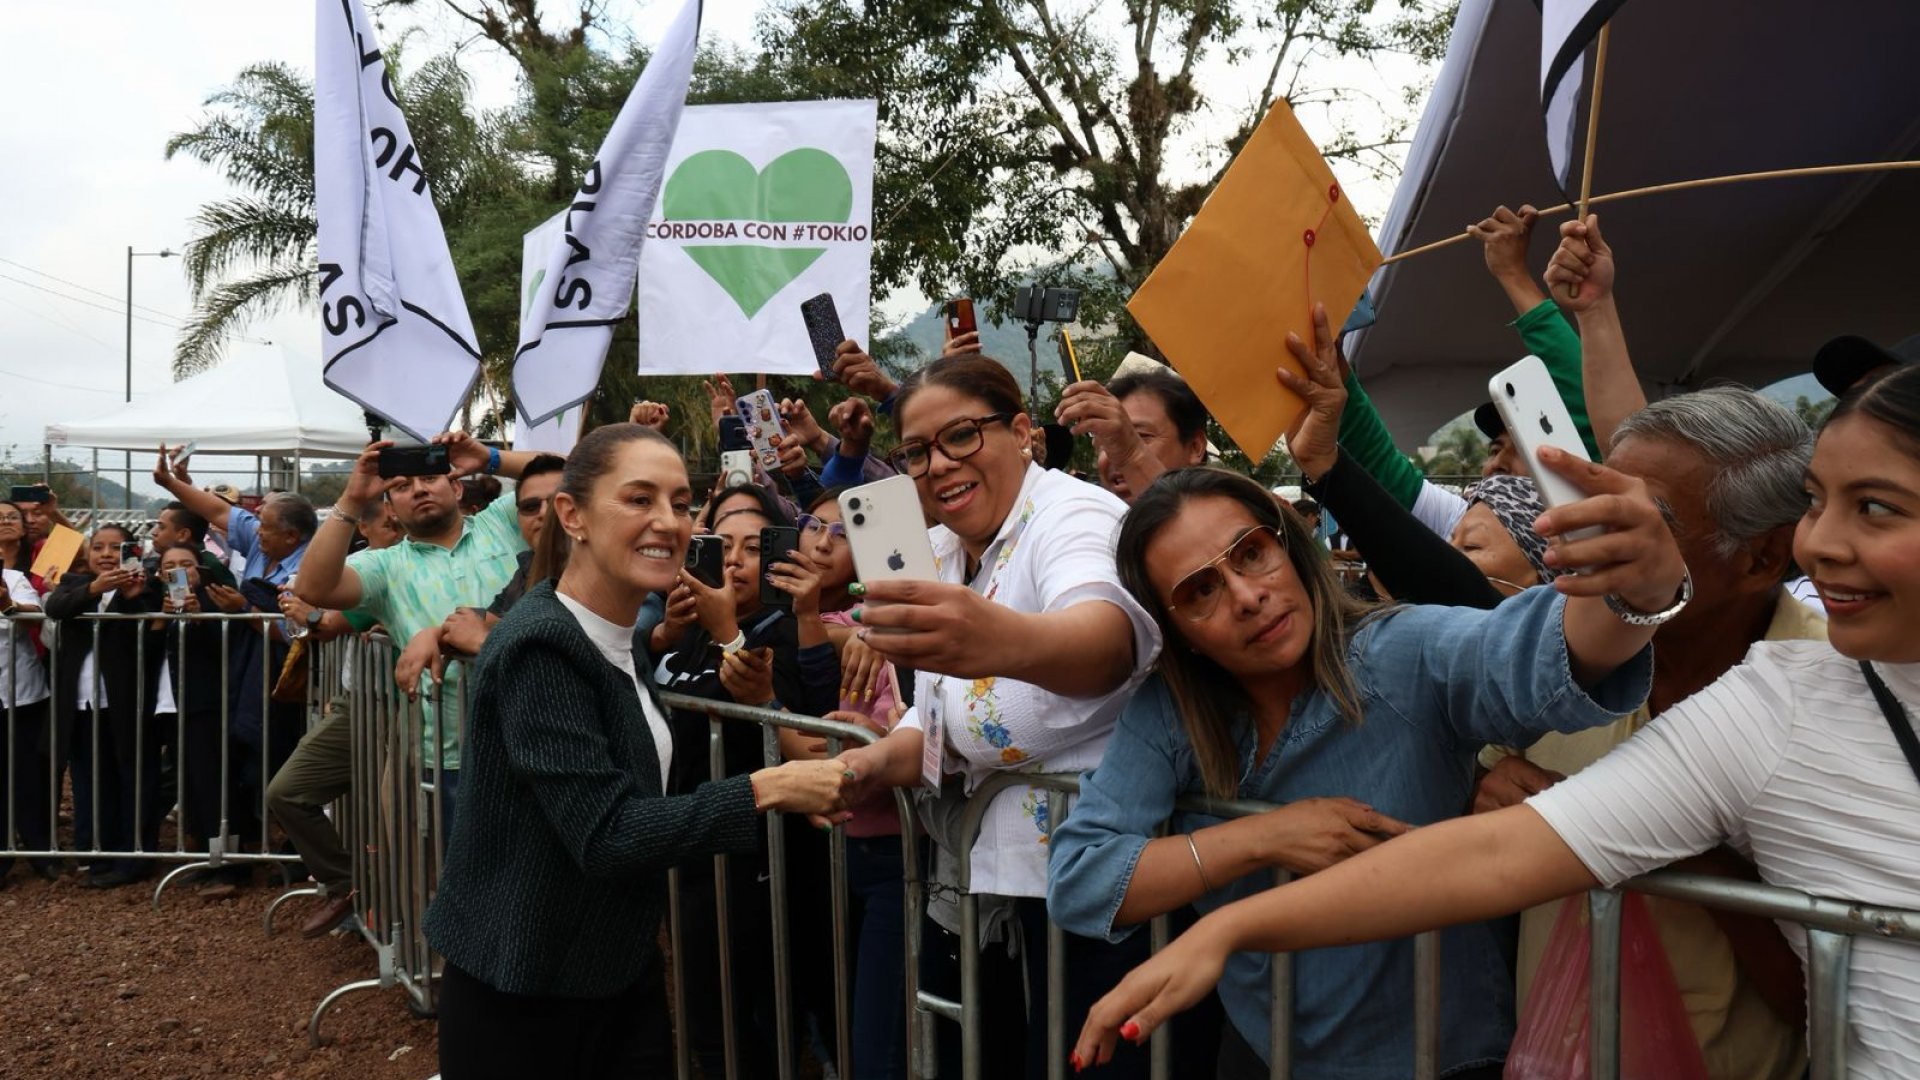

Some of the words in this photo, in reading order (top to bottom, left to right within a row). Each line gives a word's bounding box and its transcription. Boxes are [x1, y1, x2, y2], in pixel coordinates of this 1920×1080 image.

[646, 218, 738, 239] CÓRDOBA
[743, 223, 787, 240] CON
[793, 225, 868, 241] #TOKIO
